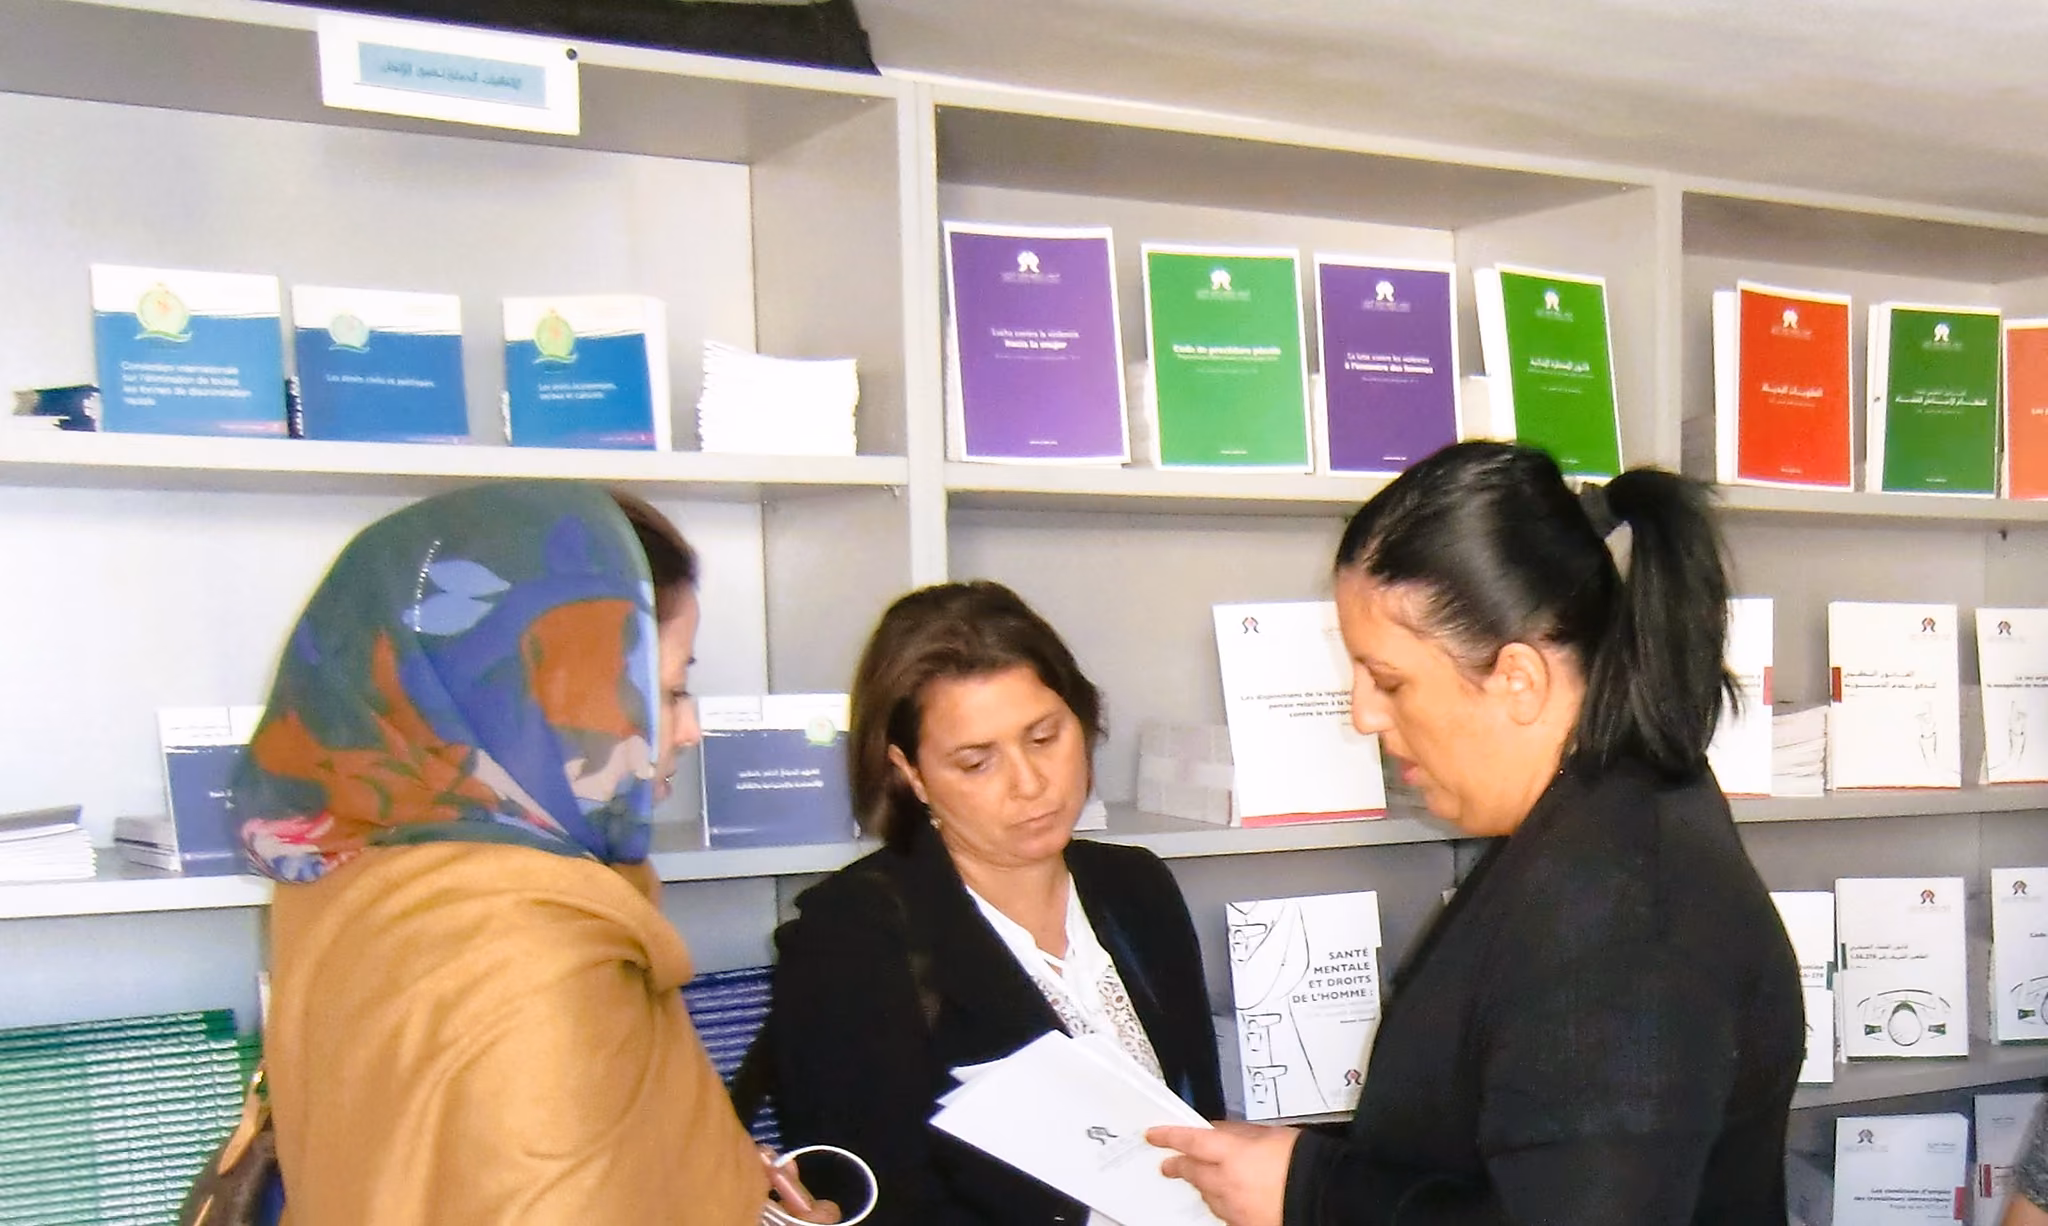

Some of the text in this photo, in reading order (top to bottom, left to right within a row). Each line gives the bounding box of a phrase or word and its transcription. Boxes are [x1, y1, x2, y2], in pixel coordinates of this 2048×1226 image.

[1328, 946, 1369, 960] SANTÉ
[1313, 962, 1371, 975] MENTALE
[1308, 975, 1372, 989] ET DROITS
[1292, 994, 1308, 1004] DE
[1311, 988, 1367, 1002] L'HOMME
